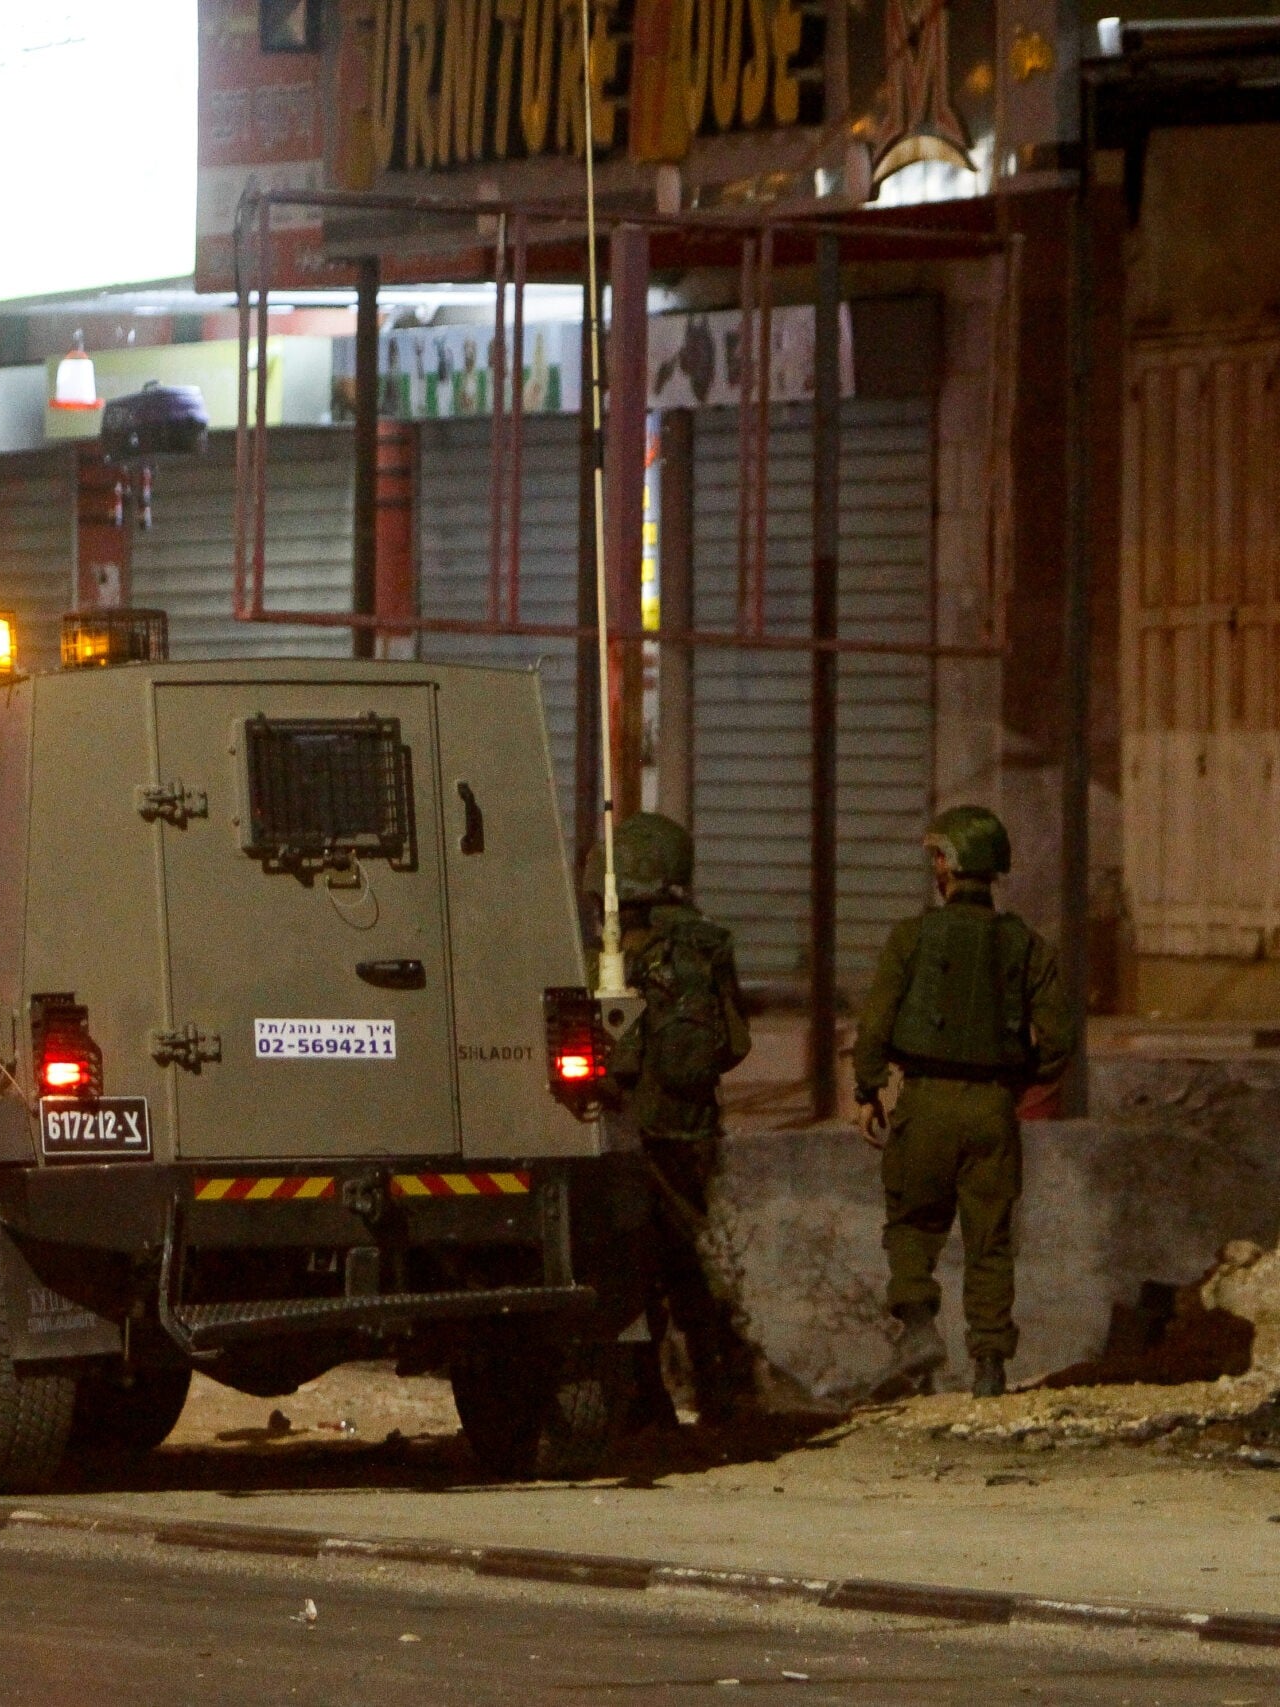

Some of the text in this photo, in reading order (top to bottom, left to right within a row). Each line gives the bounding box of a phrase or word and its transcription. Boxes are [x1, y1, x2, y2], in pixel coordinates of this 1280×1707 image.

[331, 1024, 356, 1034] אני
[366, 1024, 392, 1037] איך
[258, 1038, 393, 1054] 02-5694211
[458, 1046, 532, 1060] SHLADOT
